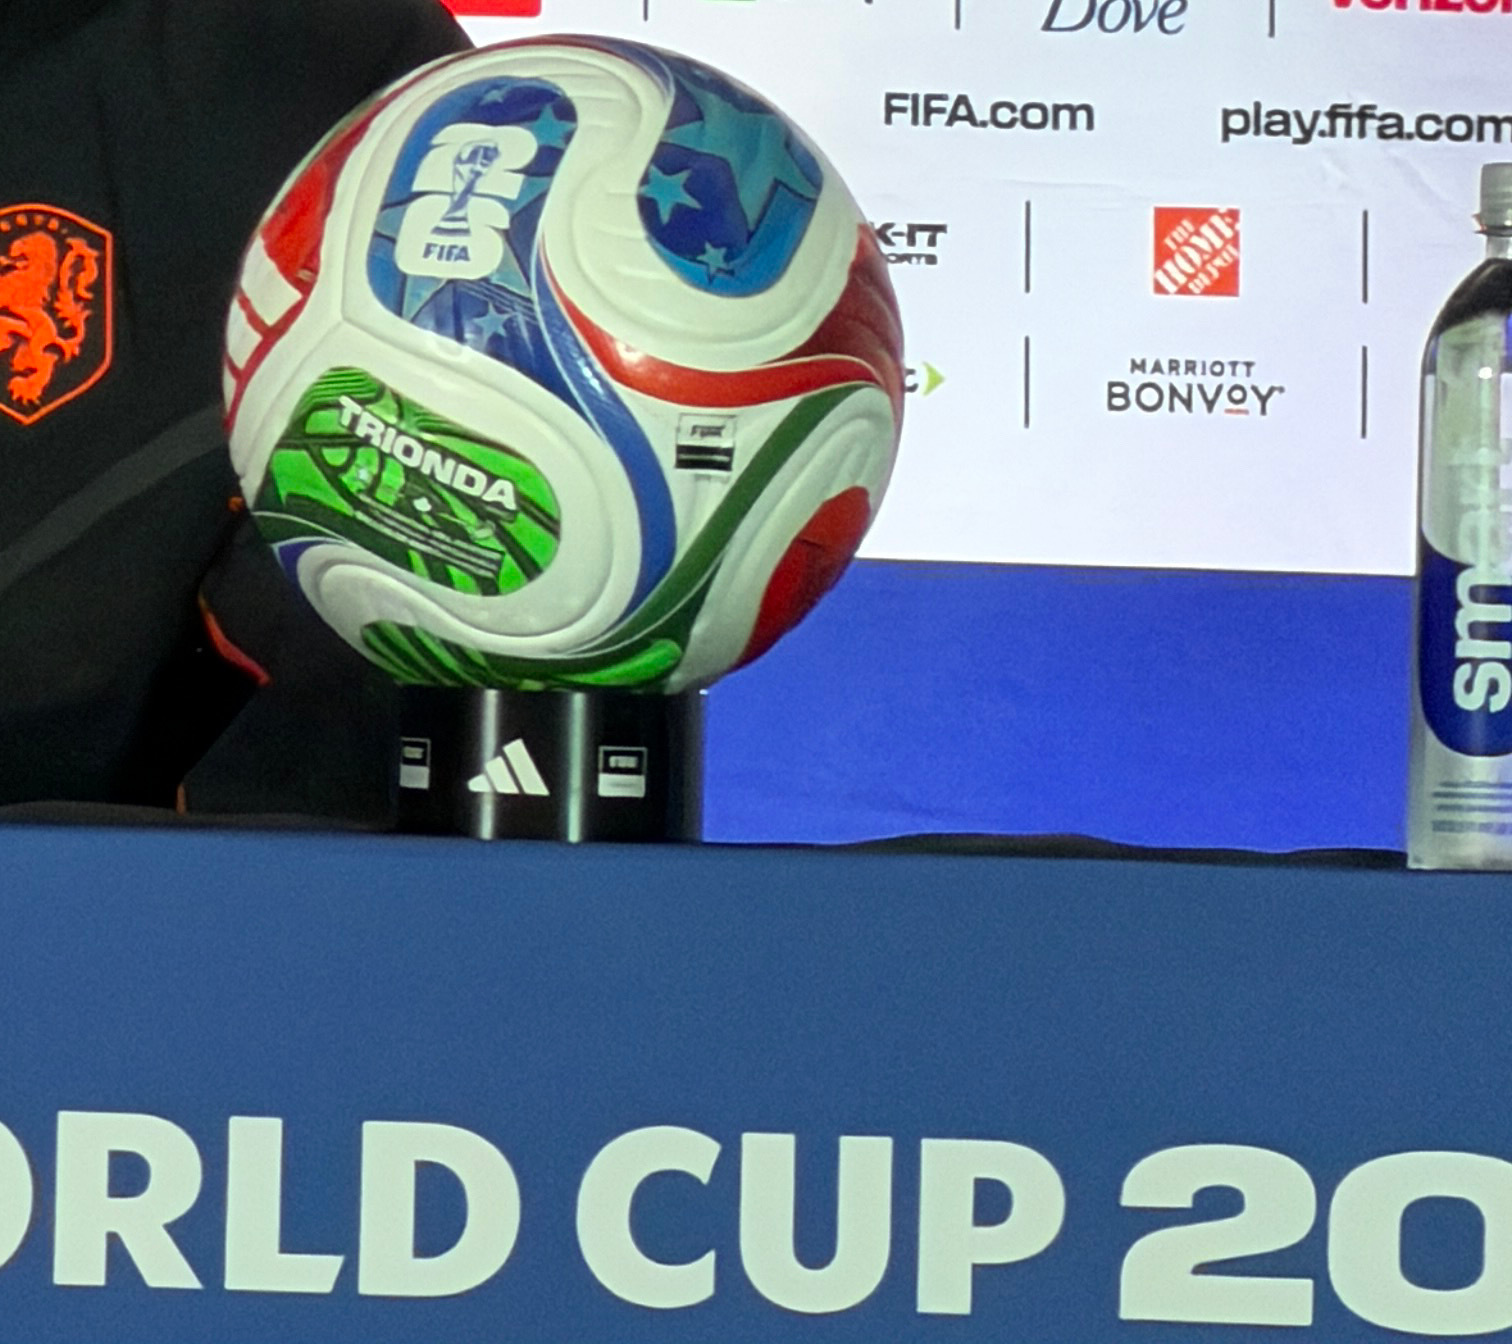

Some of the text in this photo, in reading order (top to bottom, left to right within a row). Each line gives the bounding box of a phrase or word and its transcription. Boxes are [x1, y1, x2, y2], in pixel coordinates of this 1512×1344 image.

[884, 92, 1095, 130] FIFA.com
[422, 242, 471, 262] FIFA
[1130, 358, 1256, 378] MARRIOTT
[1107, 381, 1275, 416] BONVOY
[339, 395, 517, 511] TRIONDA
[576, 1125, 1066, 1315] CUP
